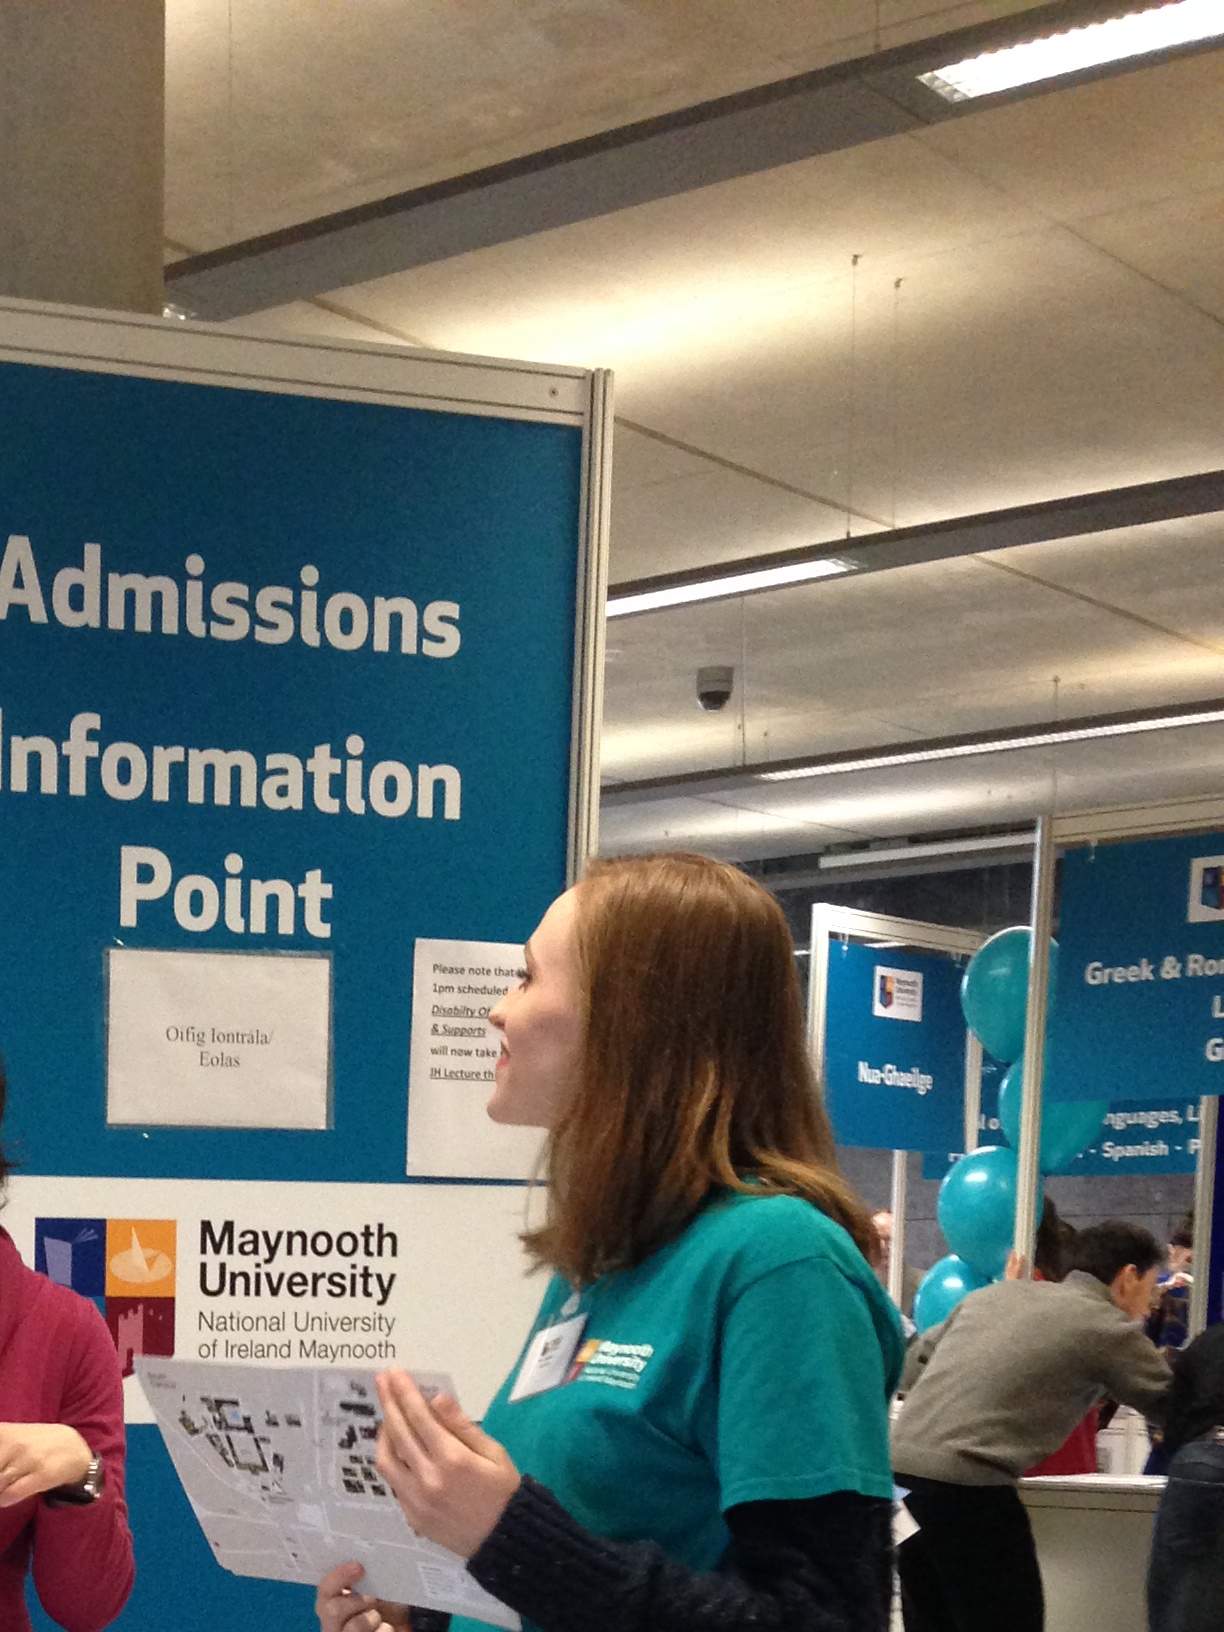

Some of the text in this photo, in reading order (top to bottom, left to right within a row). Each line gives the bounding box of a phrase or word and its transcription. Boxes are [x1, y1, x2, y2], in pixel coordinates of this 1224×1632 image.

[119, 845, 333, 938] Point
[432, 963, 515, 977] Please note that
[1084, 957, 1155, 986] Greek
[1160, 955, 1182, 981] &
[432, 983, 509, 996] 1pm scheduled
[165, 1025, 206, 1047] Oifig
[442, 1024, 487, 1037] Supports
[199, 1051, 240, 1068] Eolas
[430, 1046, 498, 1058] will now take
[444, 1068, 481, 1080] Lecture
[1101, 1140, 1169, 1162] Spanish
[199, 1220, 398, 1264] Maynooth
[199, 1261, 397, 1306] University
[198, 1311, 396, 1337] National University
[198, 1339, 396, 1363] of Ireland Maynooth
